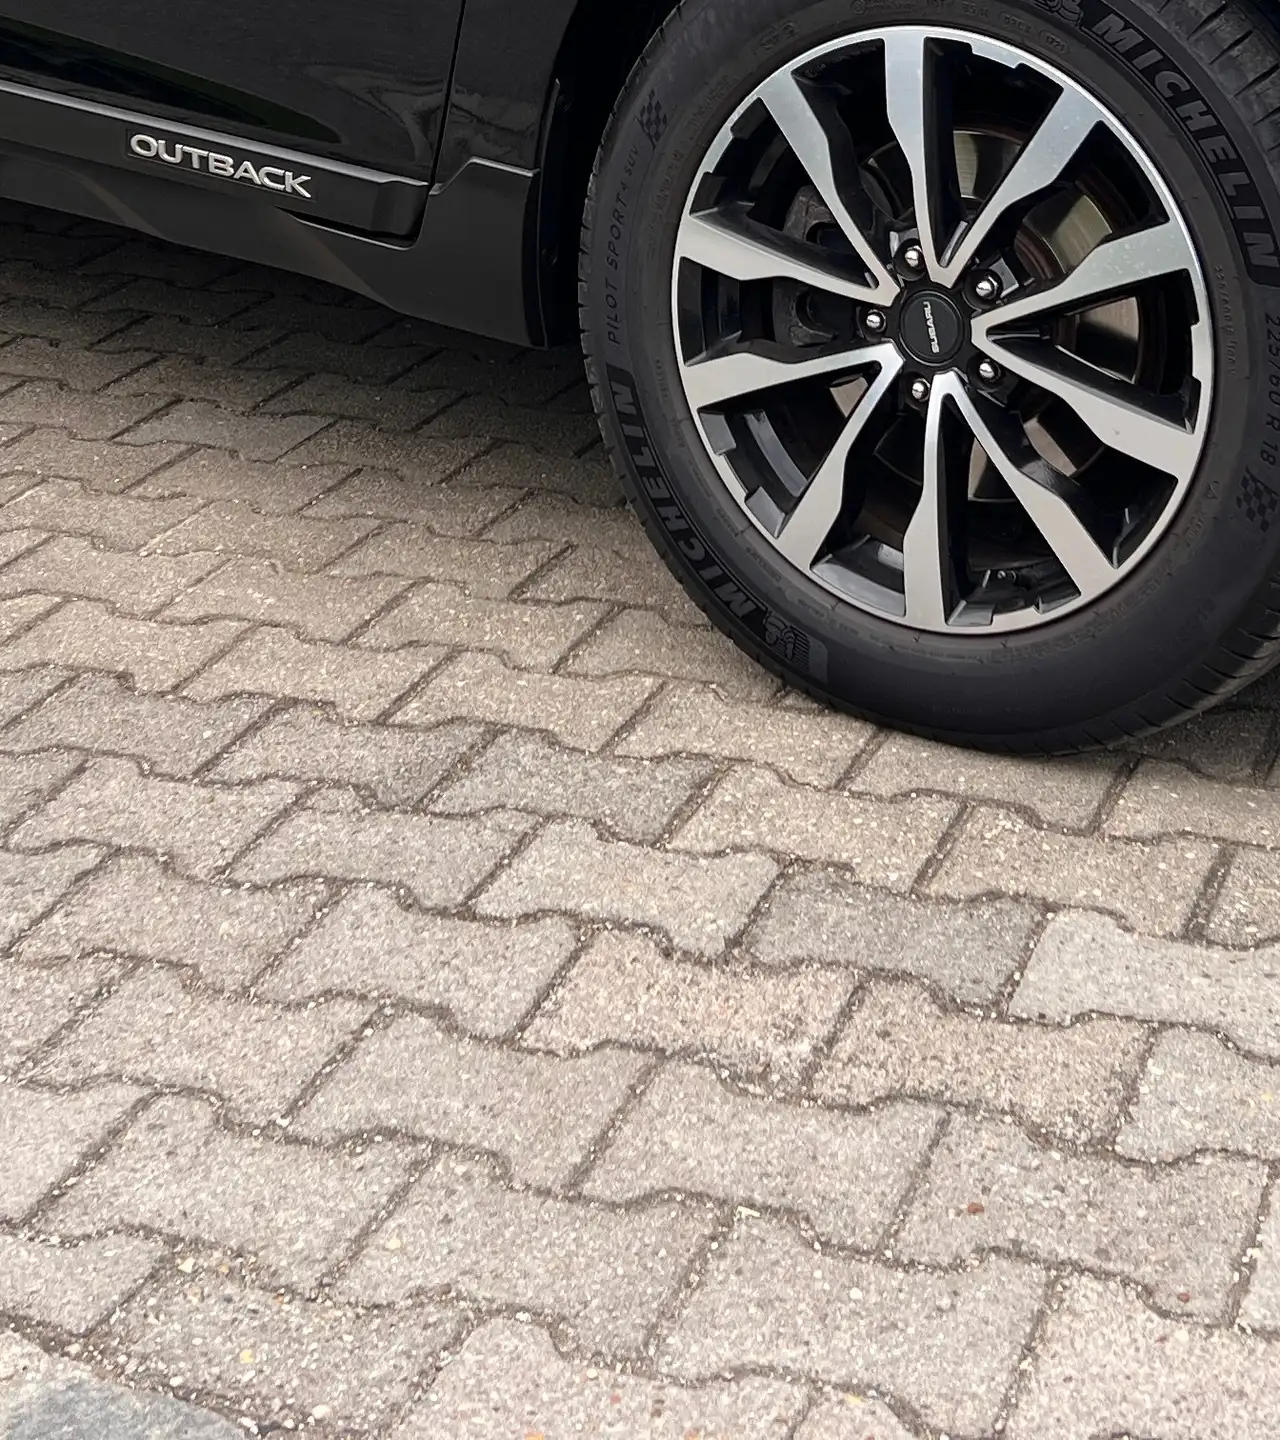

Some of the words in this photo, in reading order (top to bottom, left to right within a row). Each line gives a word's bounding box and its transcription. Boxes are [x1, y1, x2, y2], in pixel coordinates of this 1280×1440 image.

[130, 134, 312, 198] OUTBACK
[606, 192, 631, 270] SPORT
[606, 277, 622, 345] PILOT
[1260, 441, 1279, 467] 18
[611, 381, 758, 618] MICHELIN
